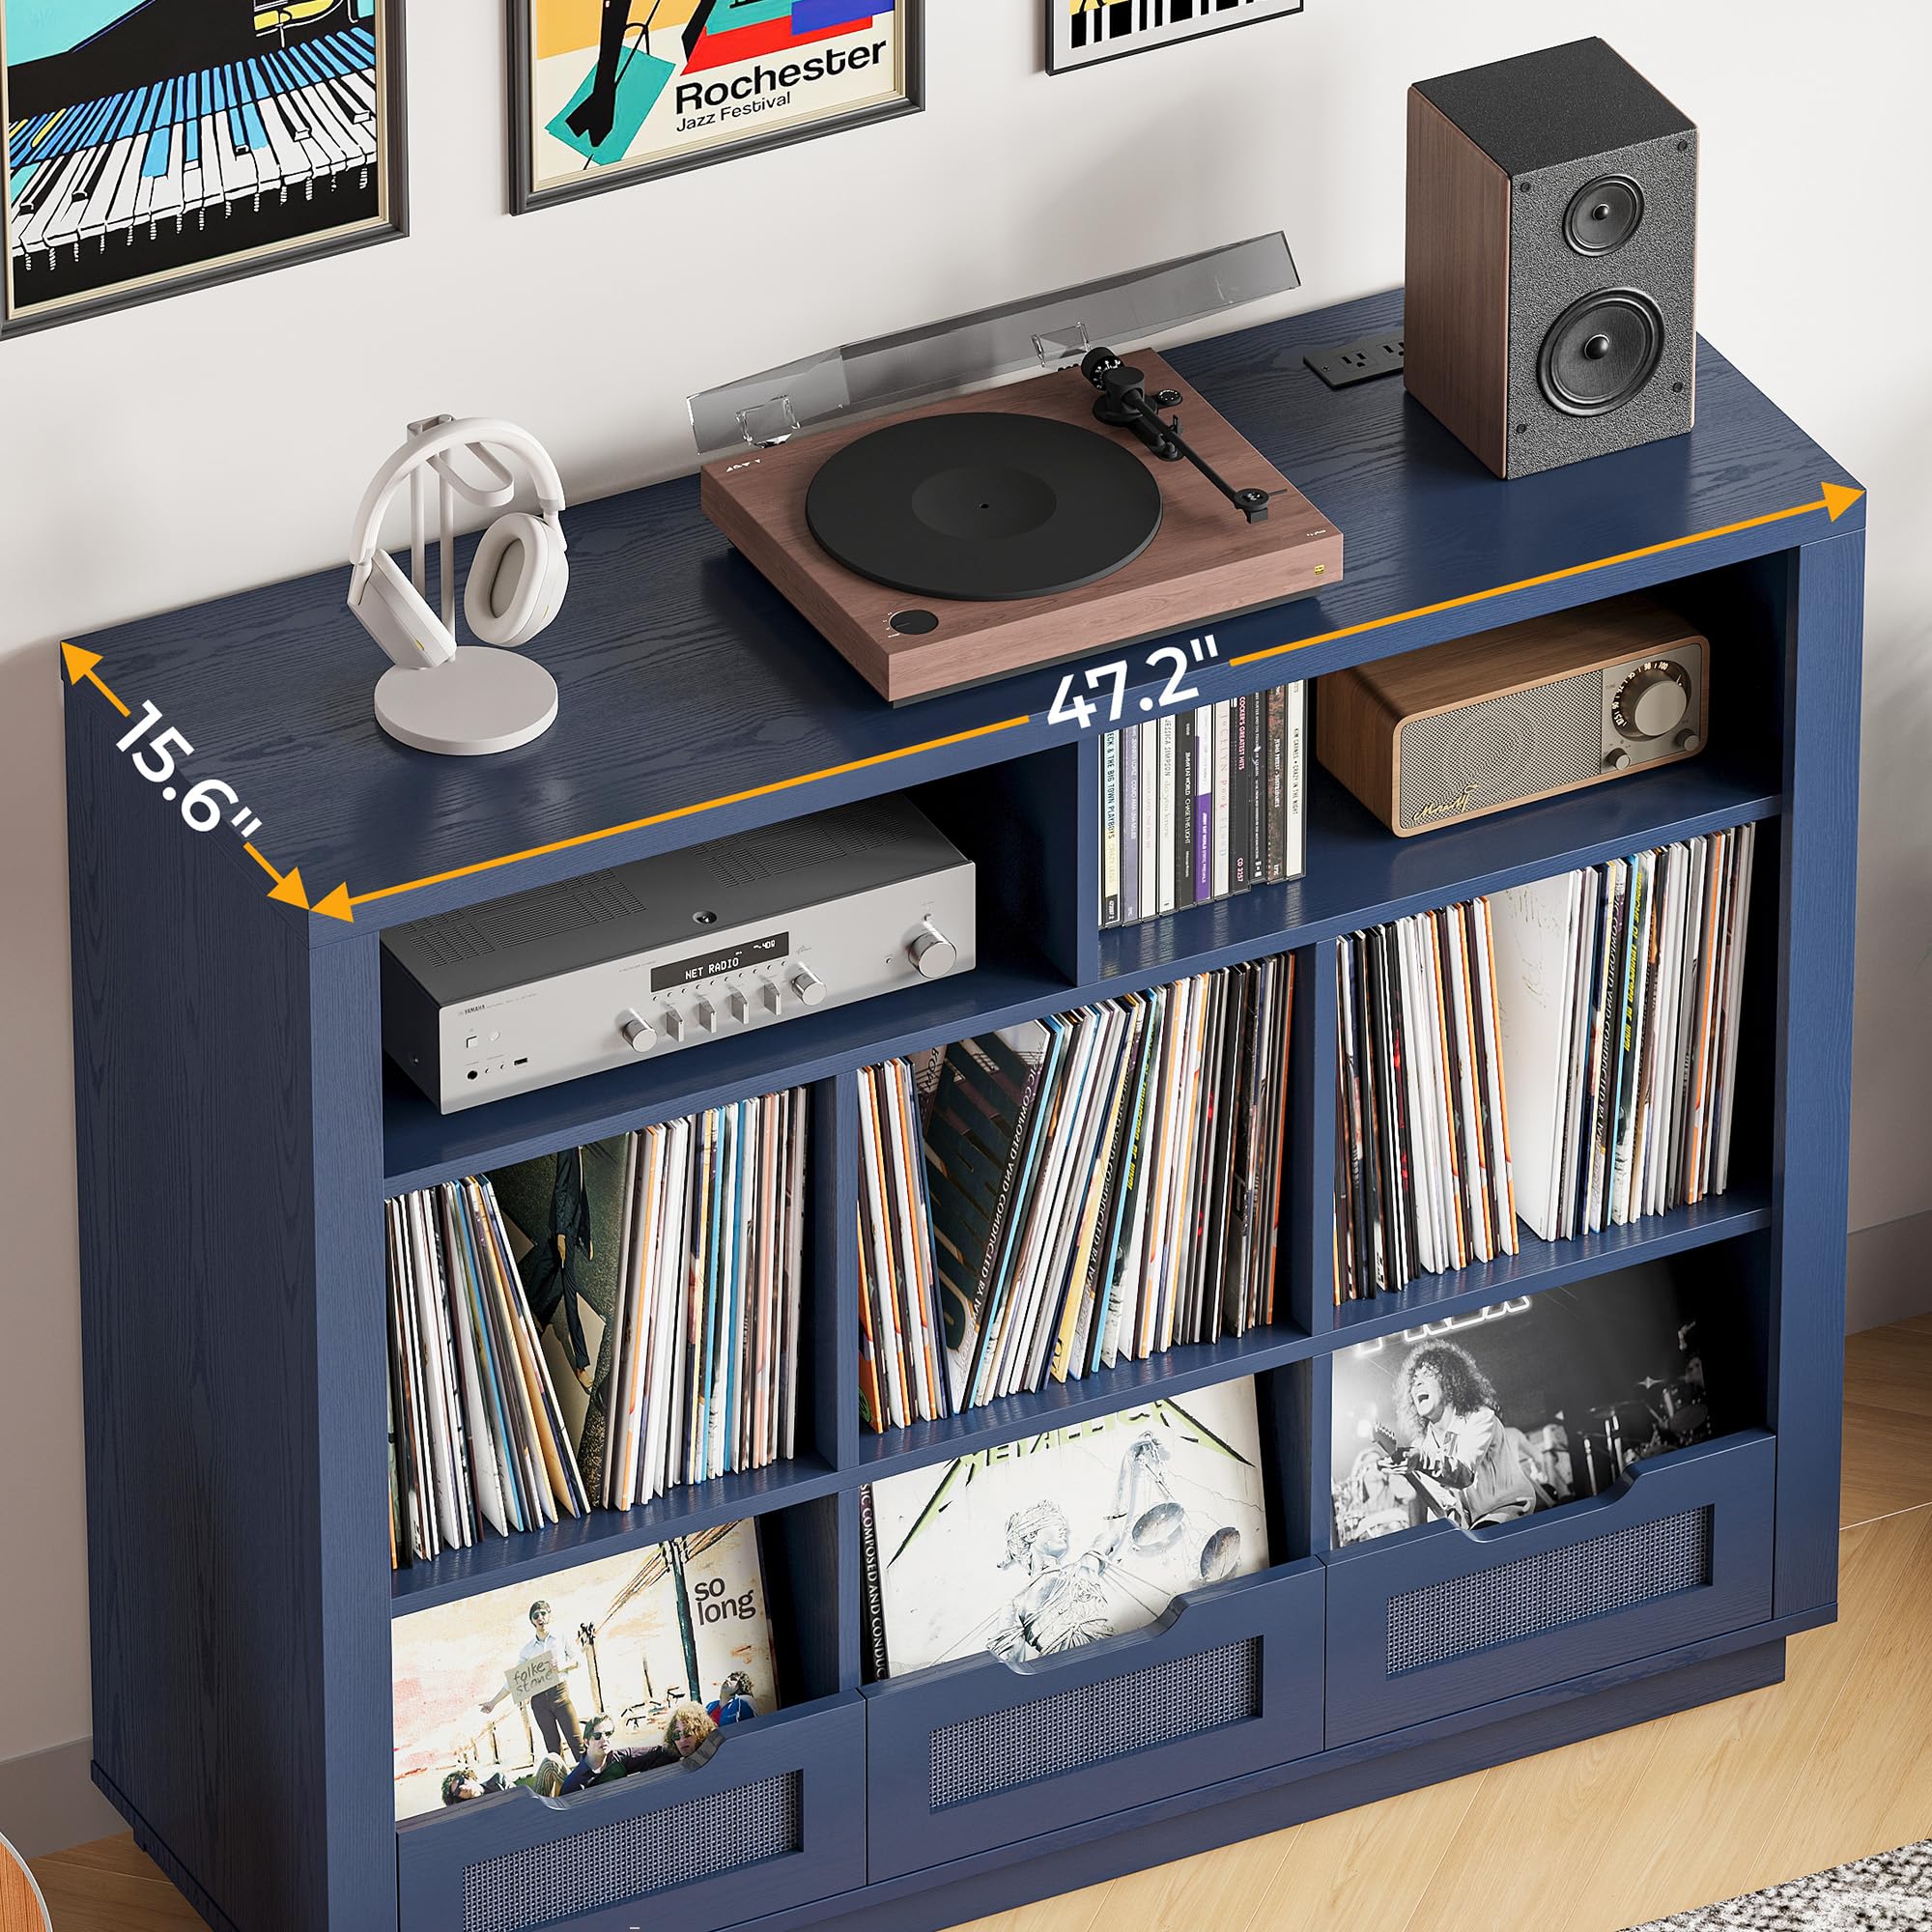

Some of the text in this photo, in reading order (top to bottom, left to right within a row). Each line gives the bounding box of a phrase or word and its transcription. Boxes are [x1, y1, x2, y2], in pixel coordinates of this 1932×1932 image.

[675, 40, 887, 115] Rochester
[676, 92, 791, 132] Jazz Festival
[685, 957, 739, 980] NET RADIO
[464, 1004, 486, 1015] YAMAHA
[694, 1577, 725, 1602] so
[860, 1483, 886, 1678] SIC COMPOSED AND CONDUC
[696, 1589, 756, 1626] long
[513, 1659, 551, 1686] folke-
